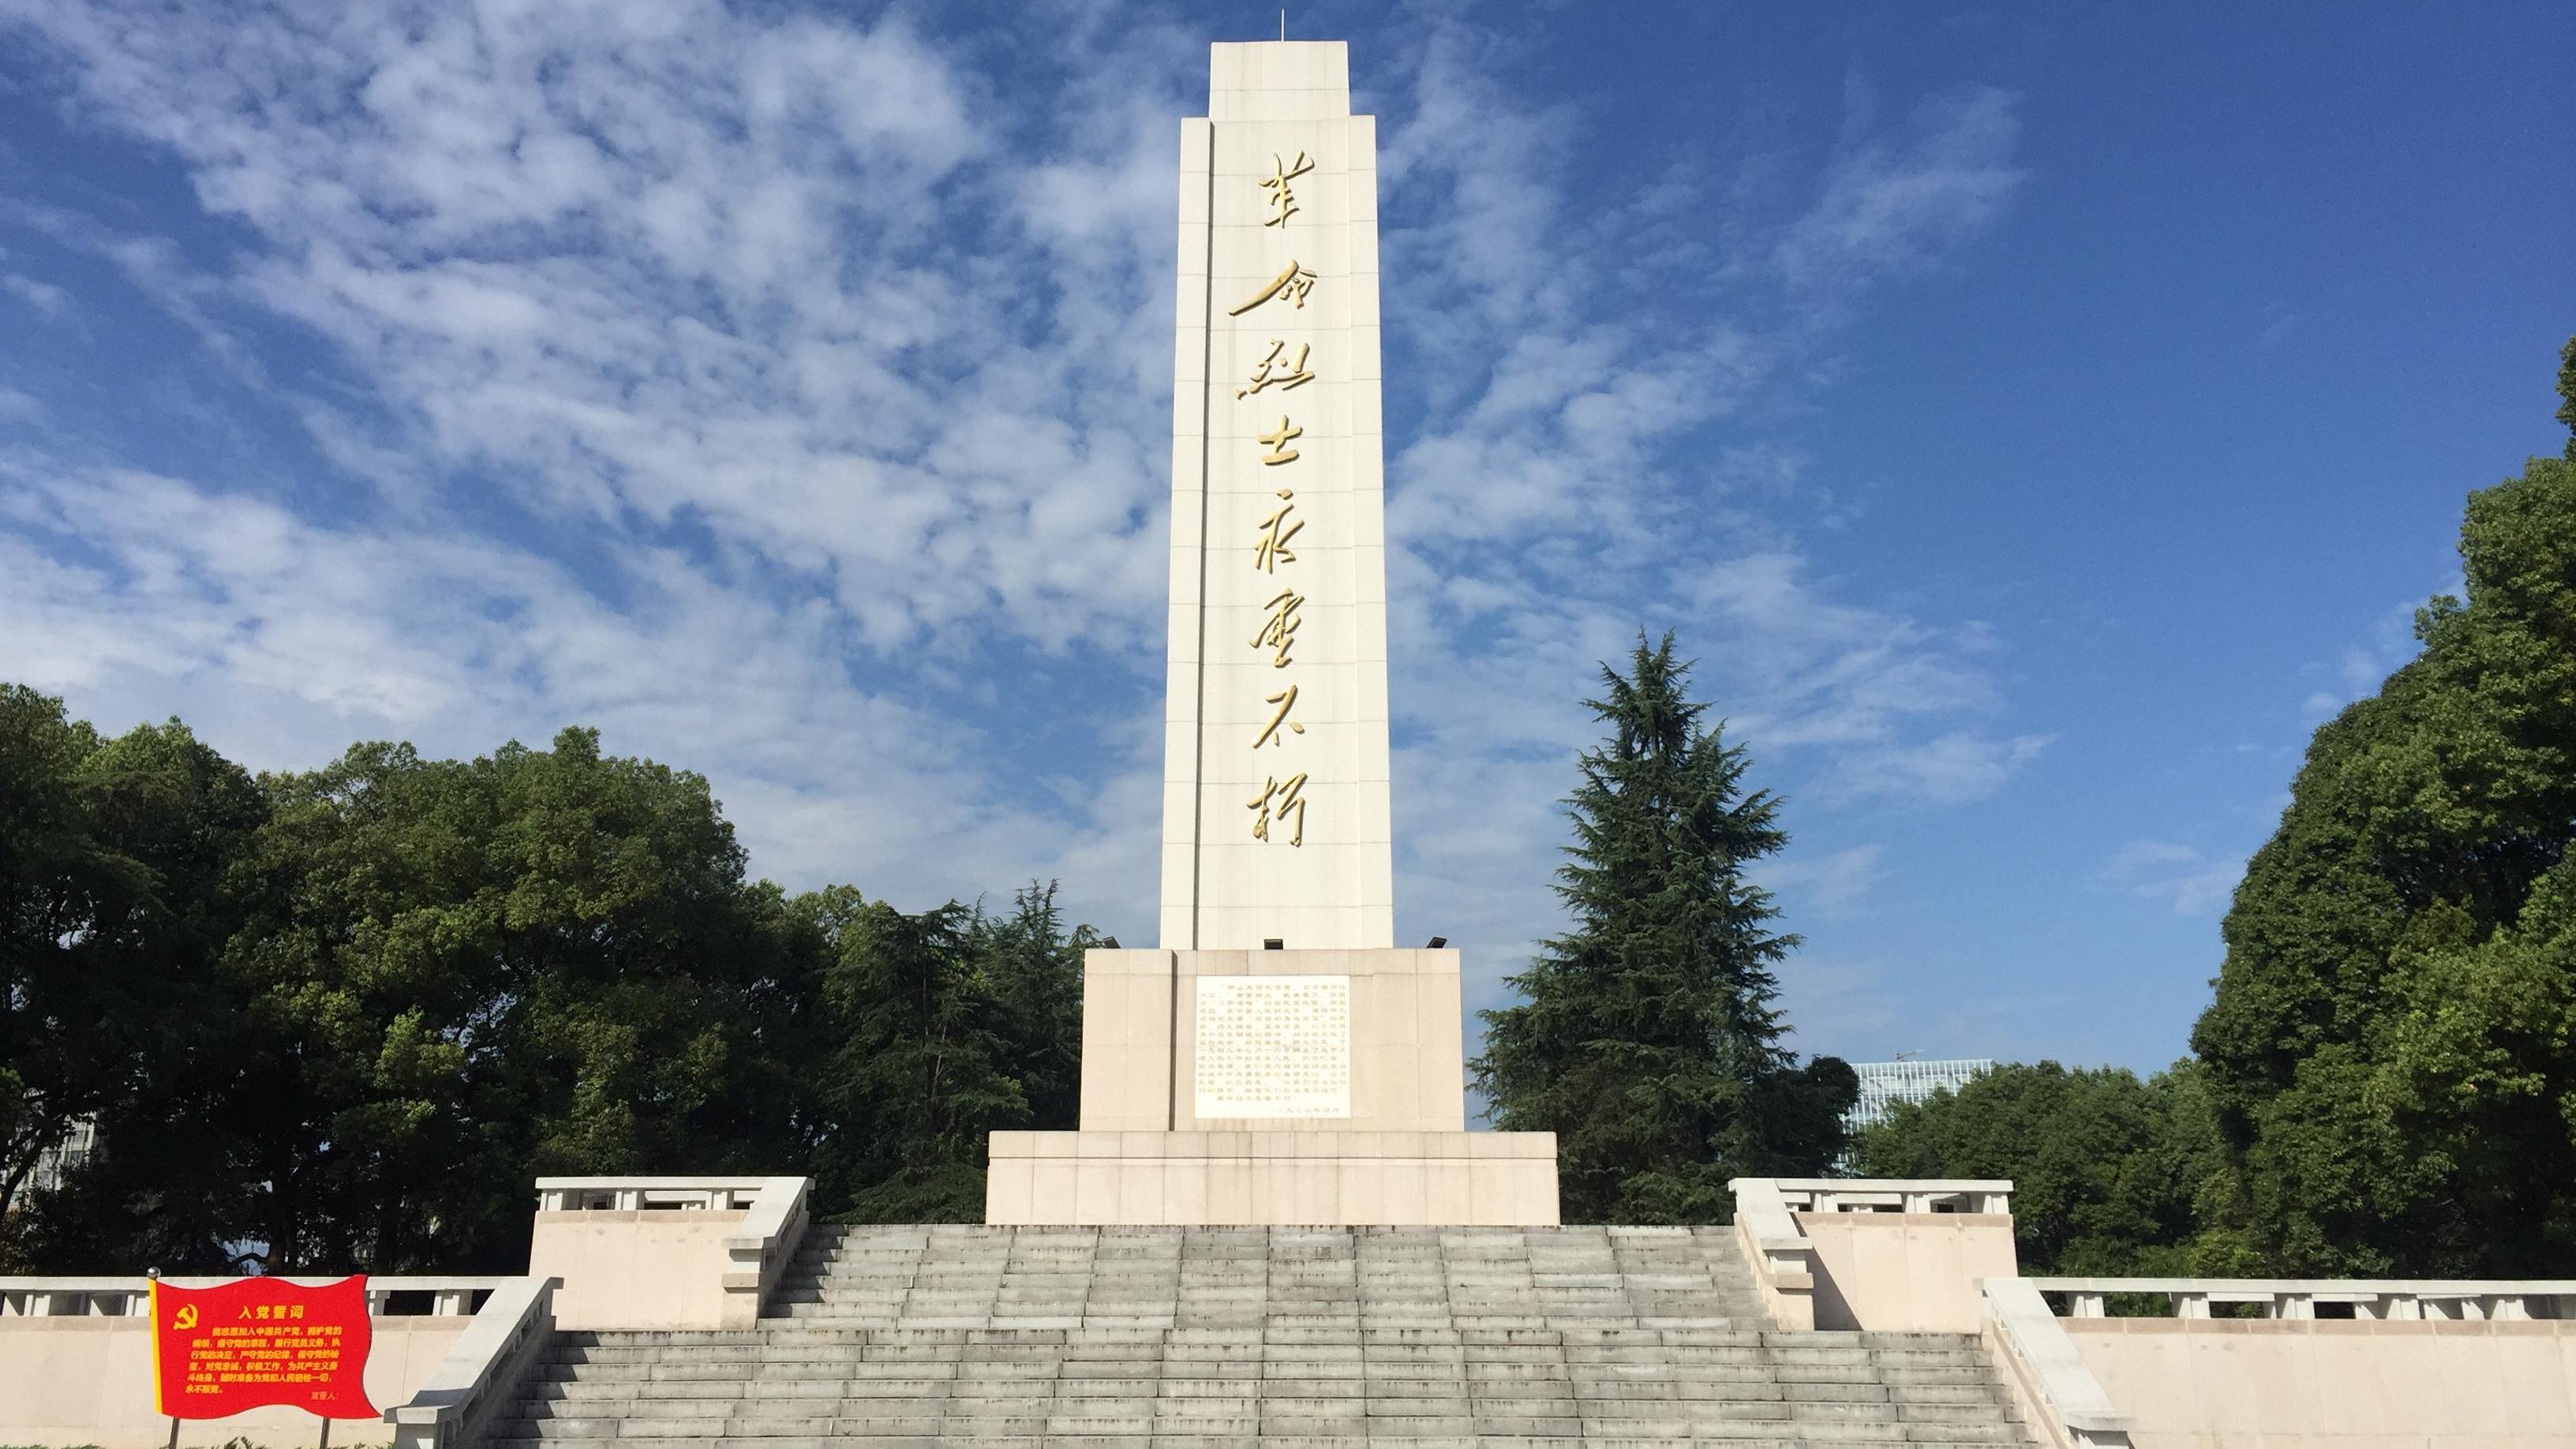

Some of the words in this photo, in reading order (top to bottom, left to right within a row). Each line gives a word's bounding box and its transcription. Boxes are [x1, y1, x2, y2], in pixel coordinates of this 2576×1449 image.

[1228, 151, 1318, 850] 革命烈士永垂不朽
[239, 1305, 304, 1319] 入党誓词
